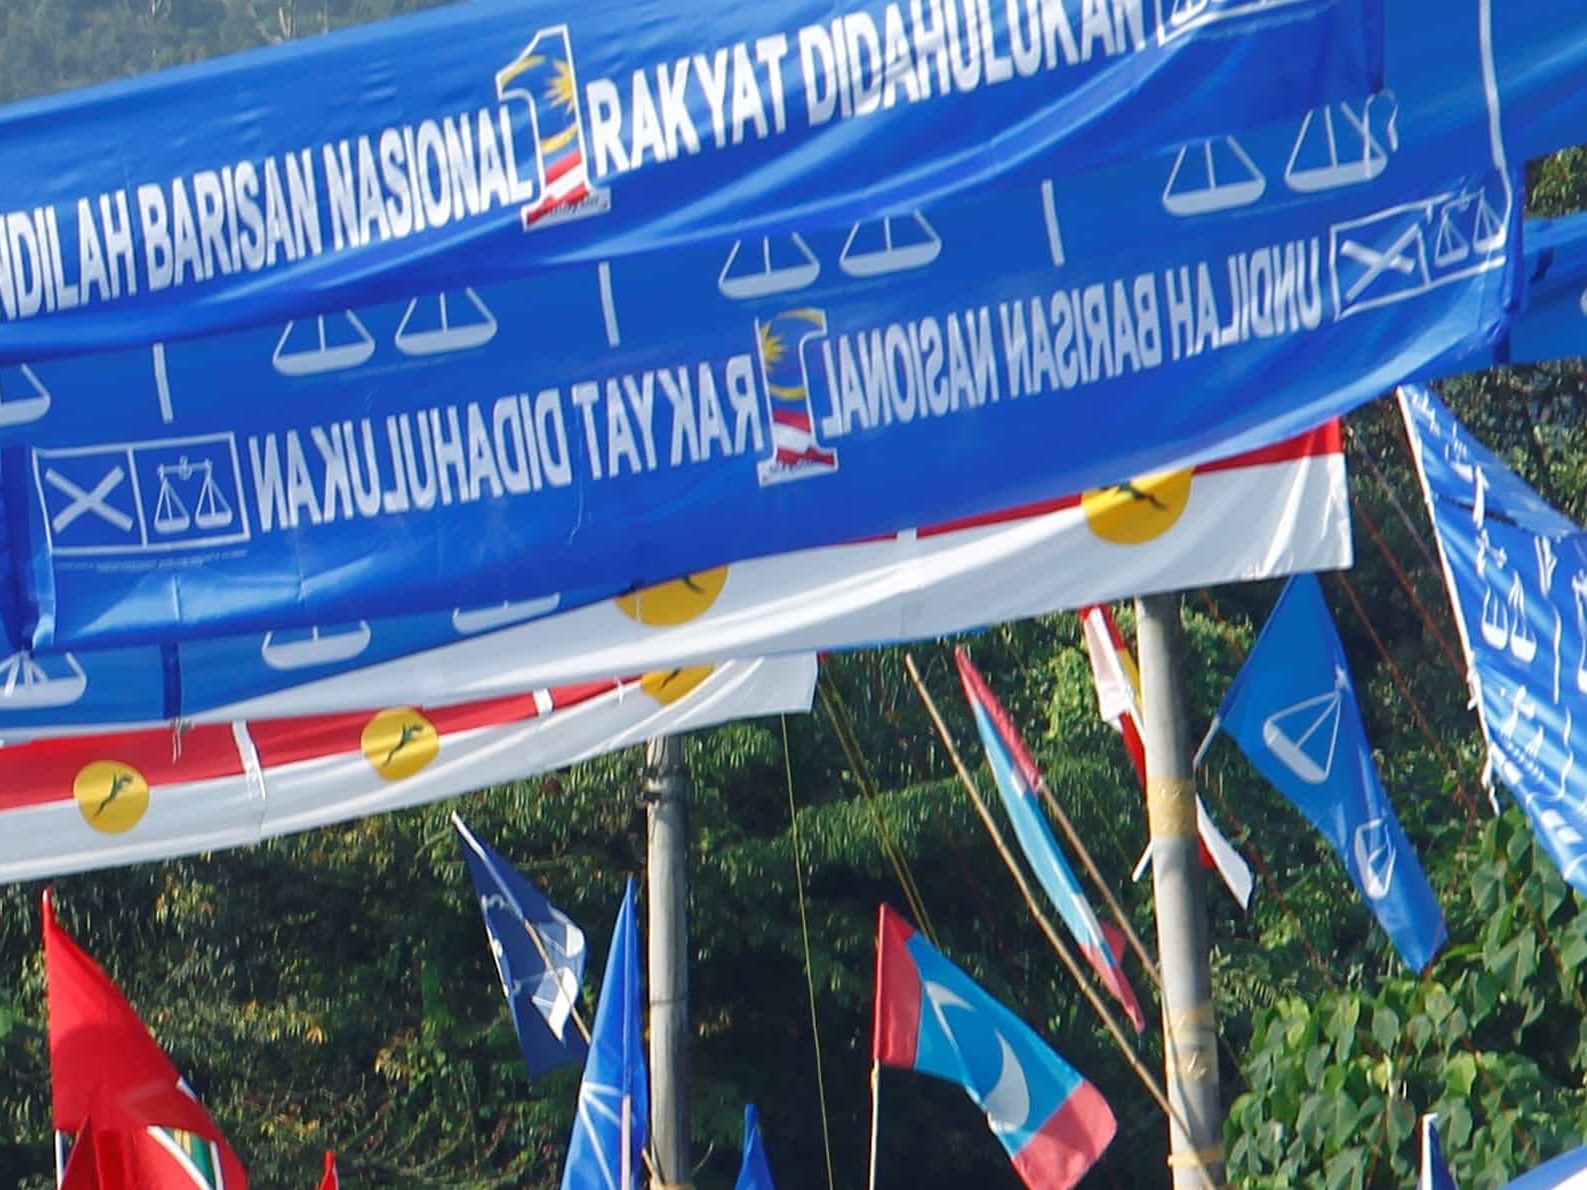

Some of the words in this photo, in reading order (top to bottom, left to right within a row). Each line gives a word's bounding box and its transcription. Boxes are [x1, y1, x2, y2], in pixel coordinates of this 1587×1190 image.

[139, 148, 319, 291] BARISAN
[323, 103, 533, 247] NASIONAL
[586, 34, 787, 178] RAKYAT
[798, 0, 1147, 126] DIDAHULUKAN
